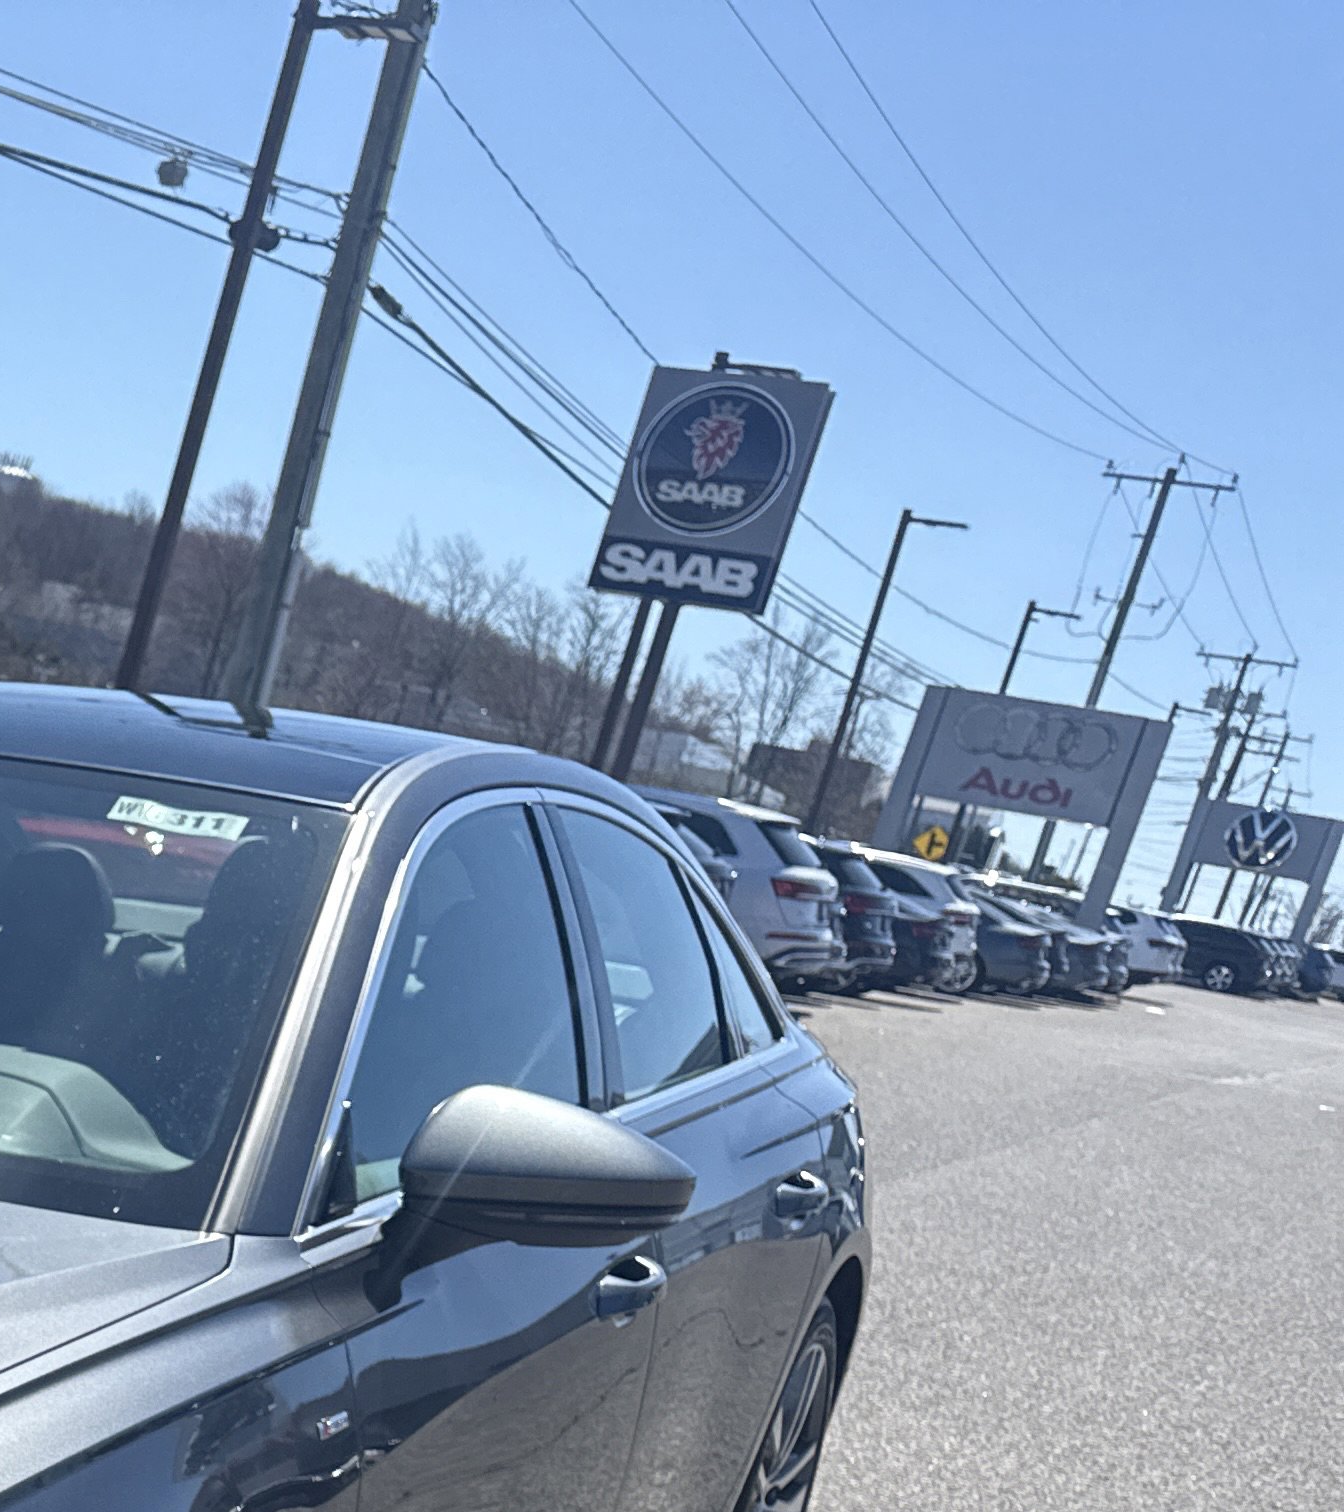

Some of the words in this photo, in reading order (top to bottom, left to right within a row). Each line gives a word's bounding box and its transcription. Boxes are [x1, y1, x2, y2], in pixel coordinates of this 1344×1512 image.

[655, 479, 746, 508] SAAB
[598, 542, 760, 599] SAAB
[958, 765, 1074, 808] Audi
